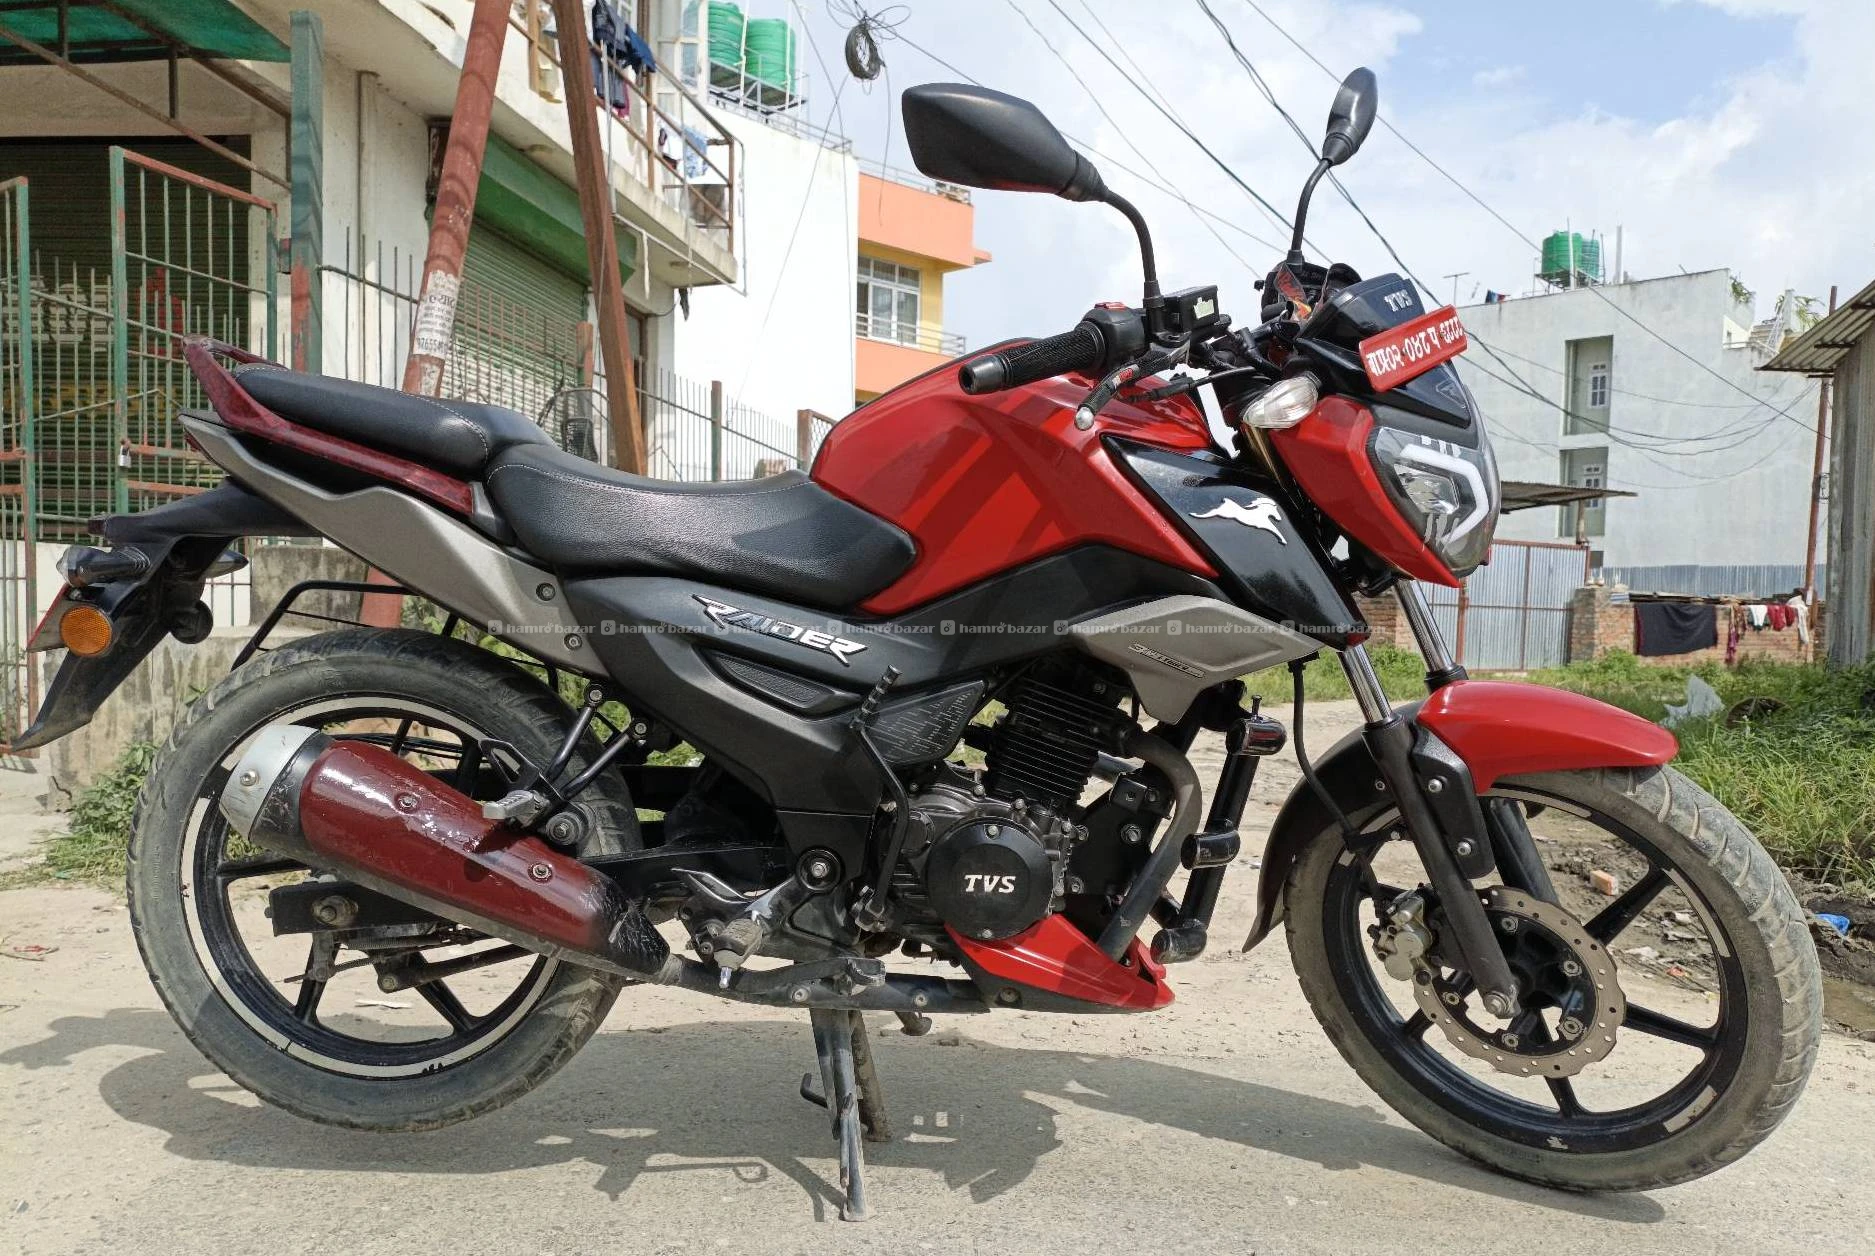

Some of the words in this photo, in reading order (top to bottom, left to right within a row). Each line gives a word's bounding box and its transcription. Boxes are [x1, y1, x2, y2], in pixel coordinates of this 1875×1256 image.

[1383, 289, 1413, 312] TVS
[692, 594, 868, 666] RAIDER
[964, 874, 1017, 893] TVS
